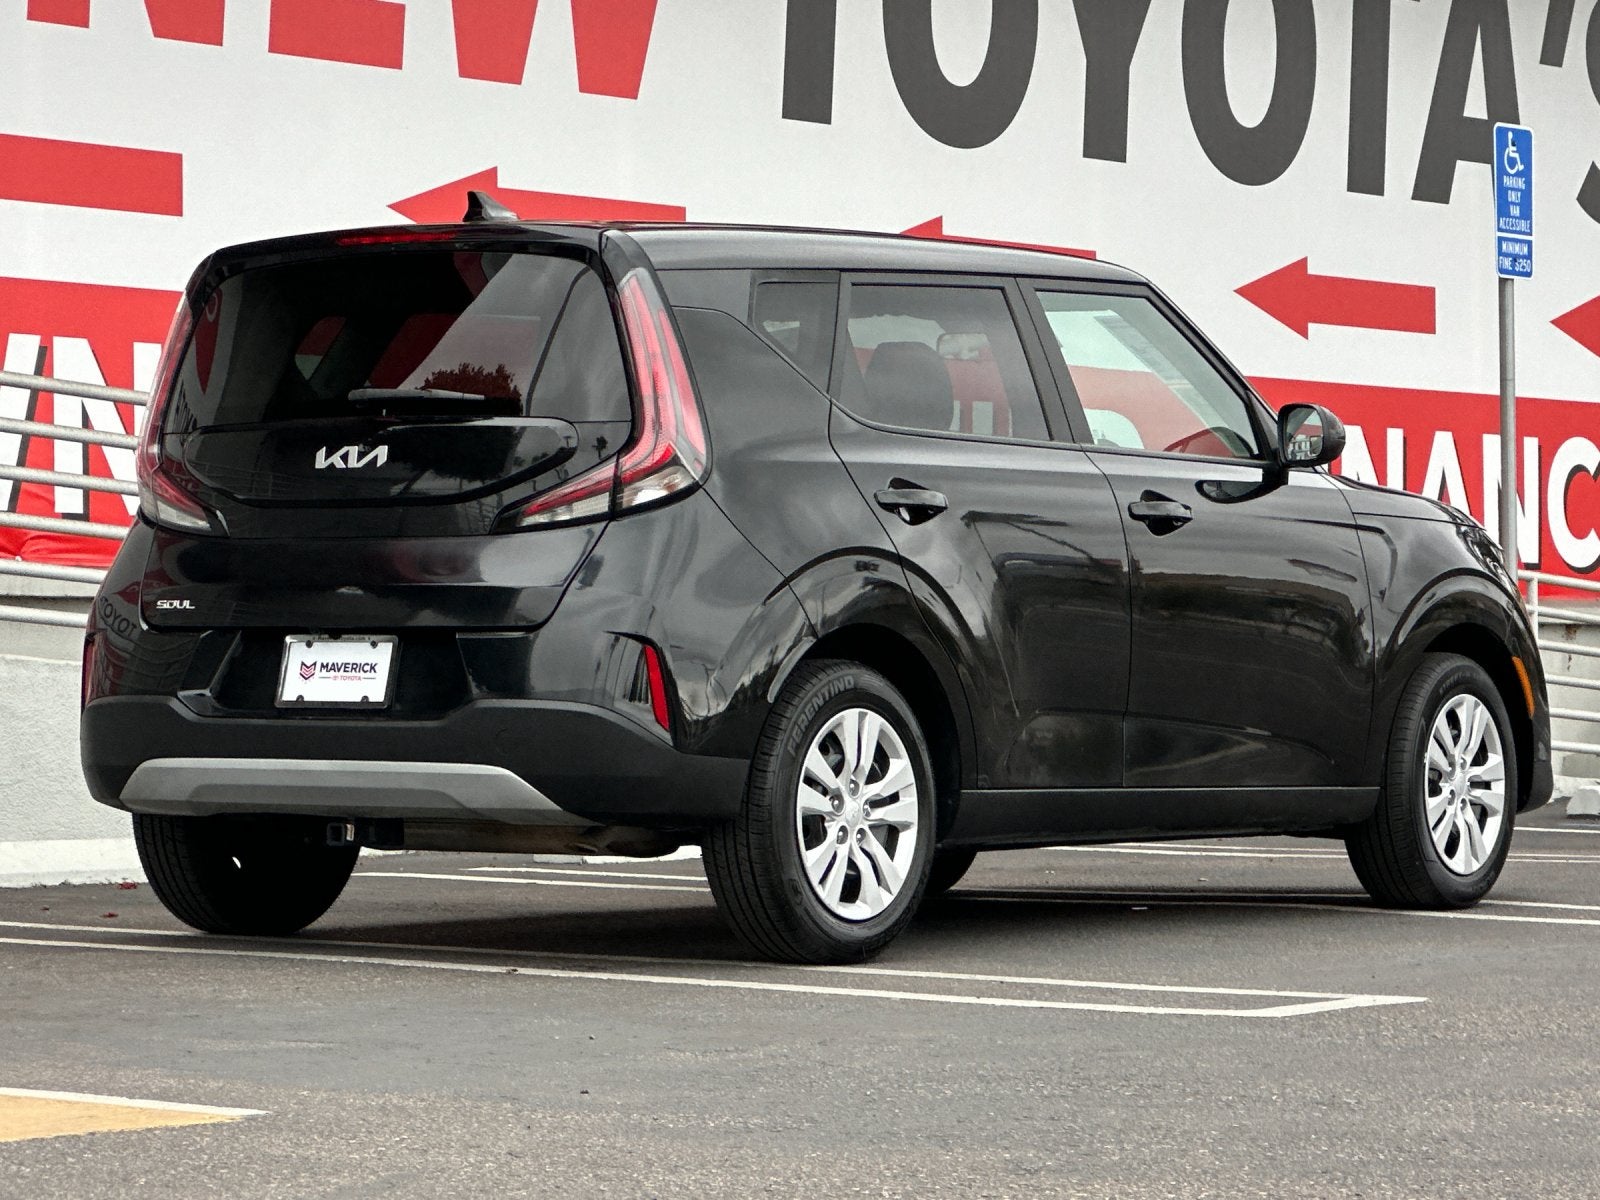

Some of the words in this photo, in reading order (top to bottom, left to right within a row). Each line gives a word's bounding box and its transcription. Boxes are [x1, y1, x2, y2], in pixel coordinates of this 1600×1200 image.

[1503, 175, 1526, 190] PARKING
[1507, 191, 1521, 203] ONLY
[1509, 205, 1520, 217] VAN
[1499, 217, 1531, 233] ACCESSIBLE
[1501, 240, 1529, 256] MINIMUM
[1499, 256, 1513, 271] FINE
[1514, 258, 1532, 273] $250
[315, 445, 388, 469] KIA
[156, 599, 195, 609] SOUL
[319, 662, 378, 674] MAVERICK
